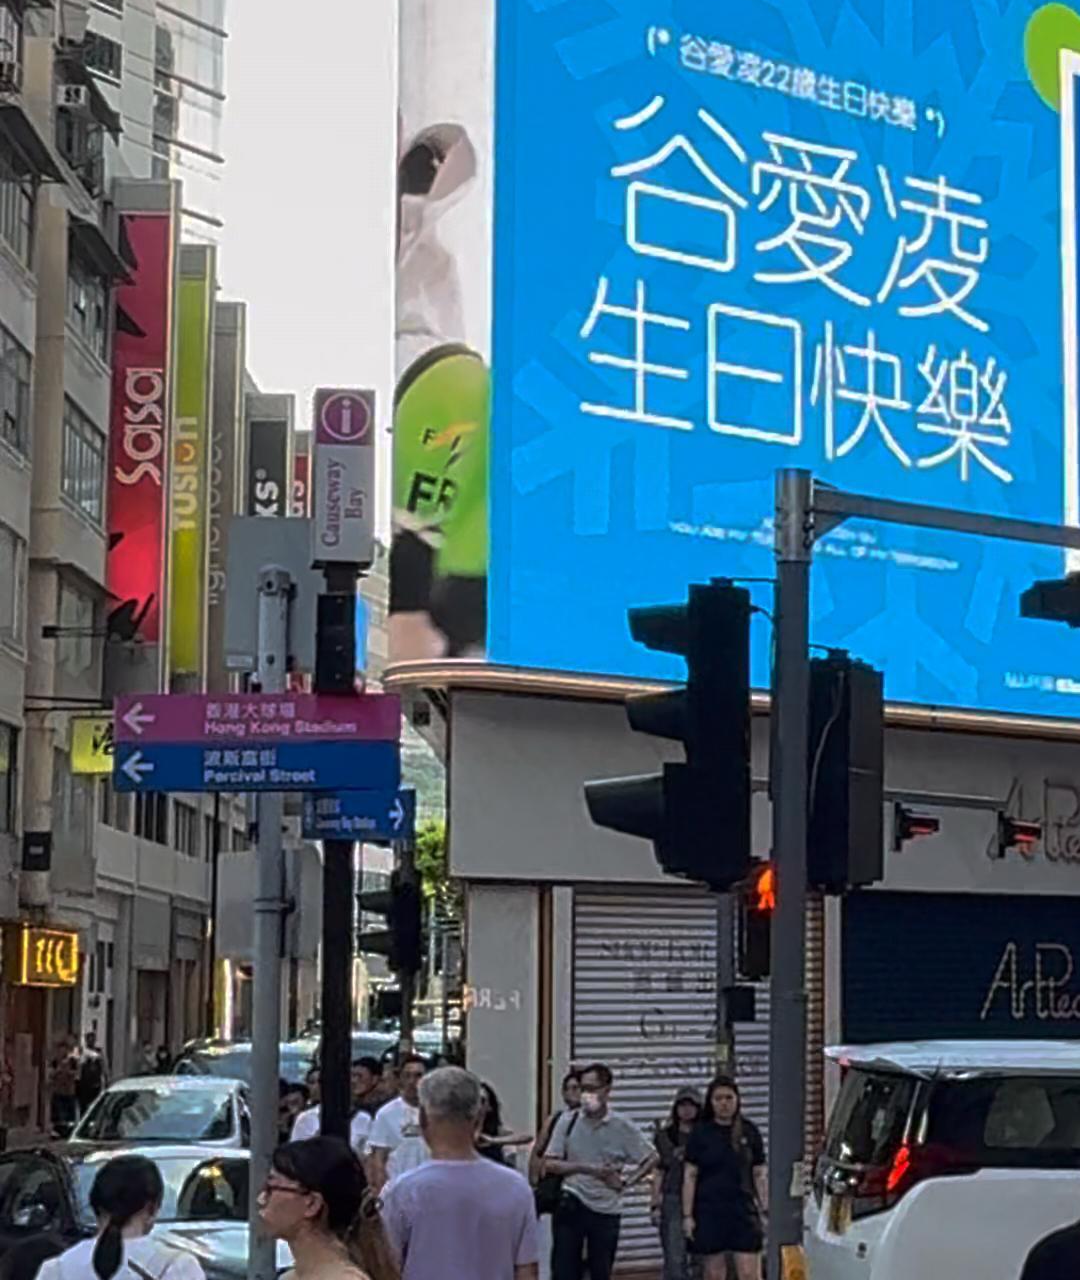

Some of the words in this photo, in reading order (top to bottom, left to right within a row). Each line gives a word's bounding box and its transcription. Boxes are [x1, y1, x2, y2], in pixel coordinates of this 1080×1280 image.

[610, 94, 990, 333] 谷愛凌
[579, 275, 1014, 484] 生日快樂
[320, 457, 346, 548] Causeway
[344, 487, 367, 520] Bay
[204, 720, 246, 737] Hong
[249, 720, 291, 736] Kong
[293, 719, 358, 734] Stadium
[203, 769, 266, 783] Percival
[268, 768, 316, 783] Street
